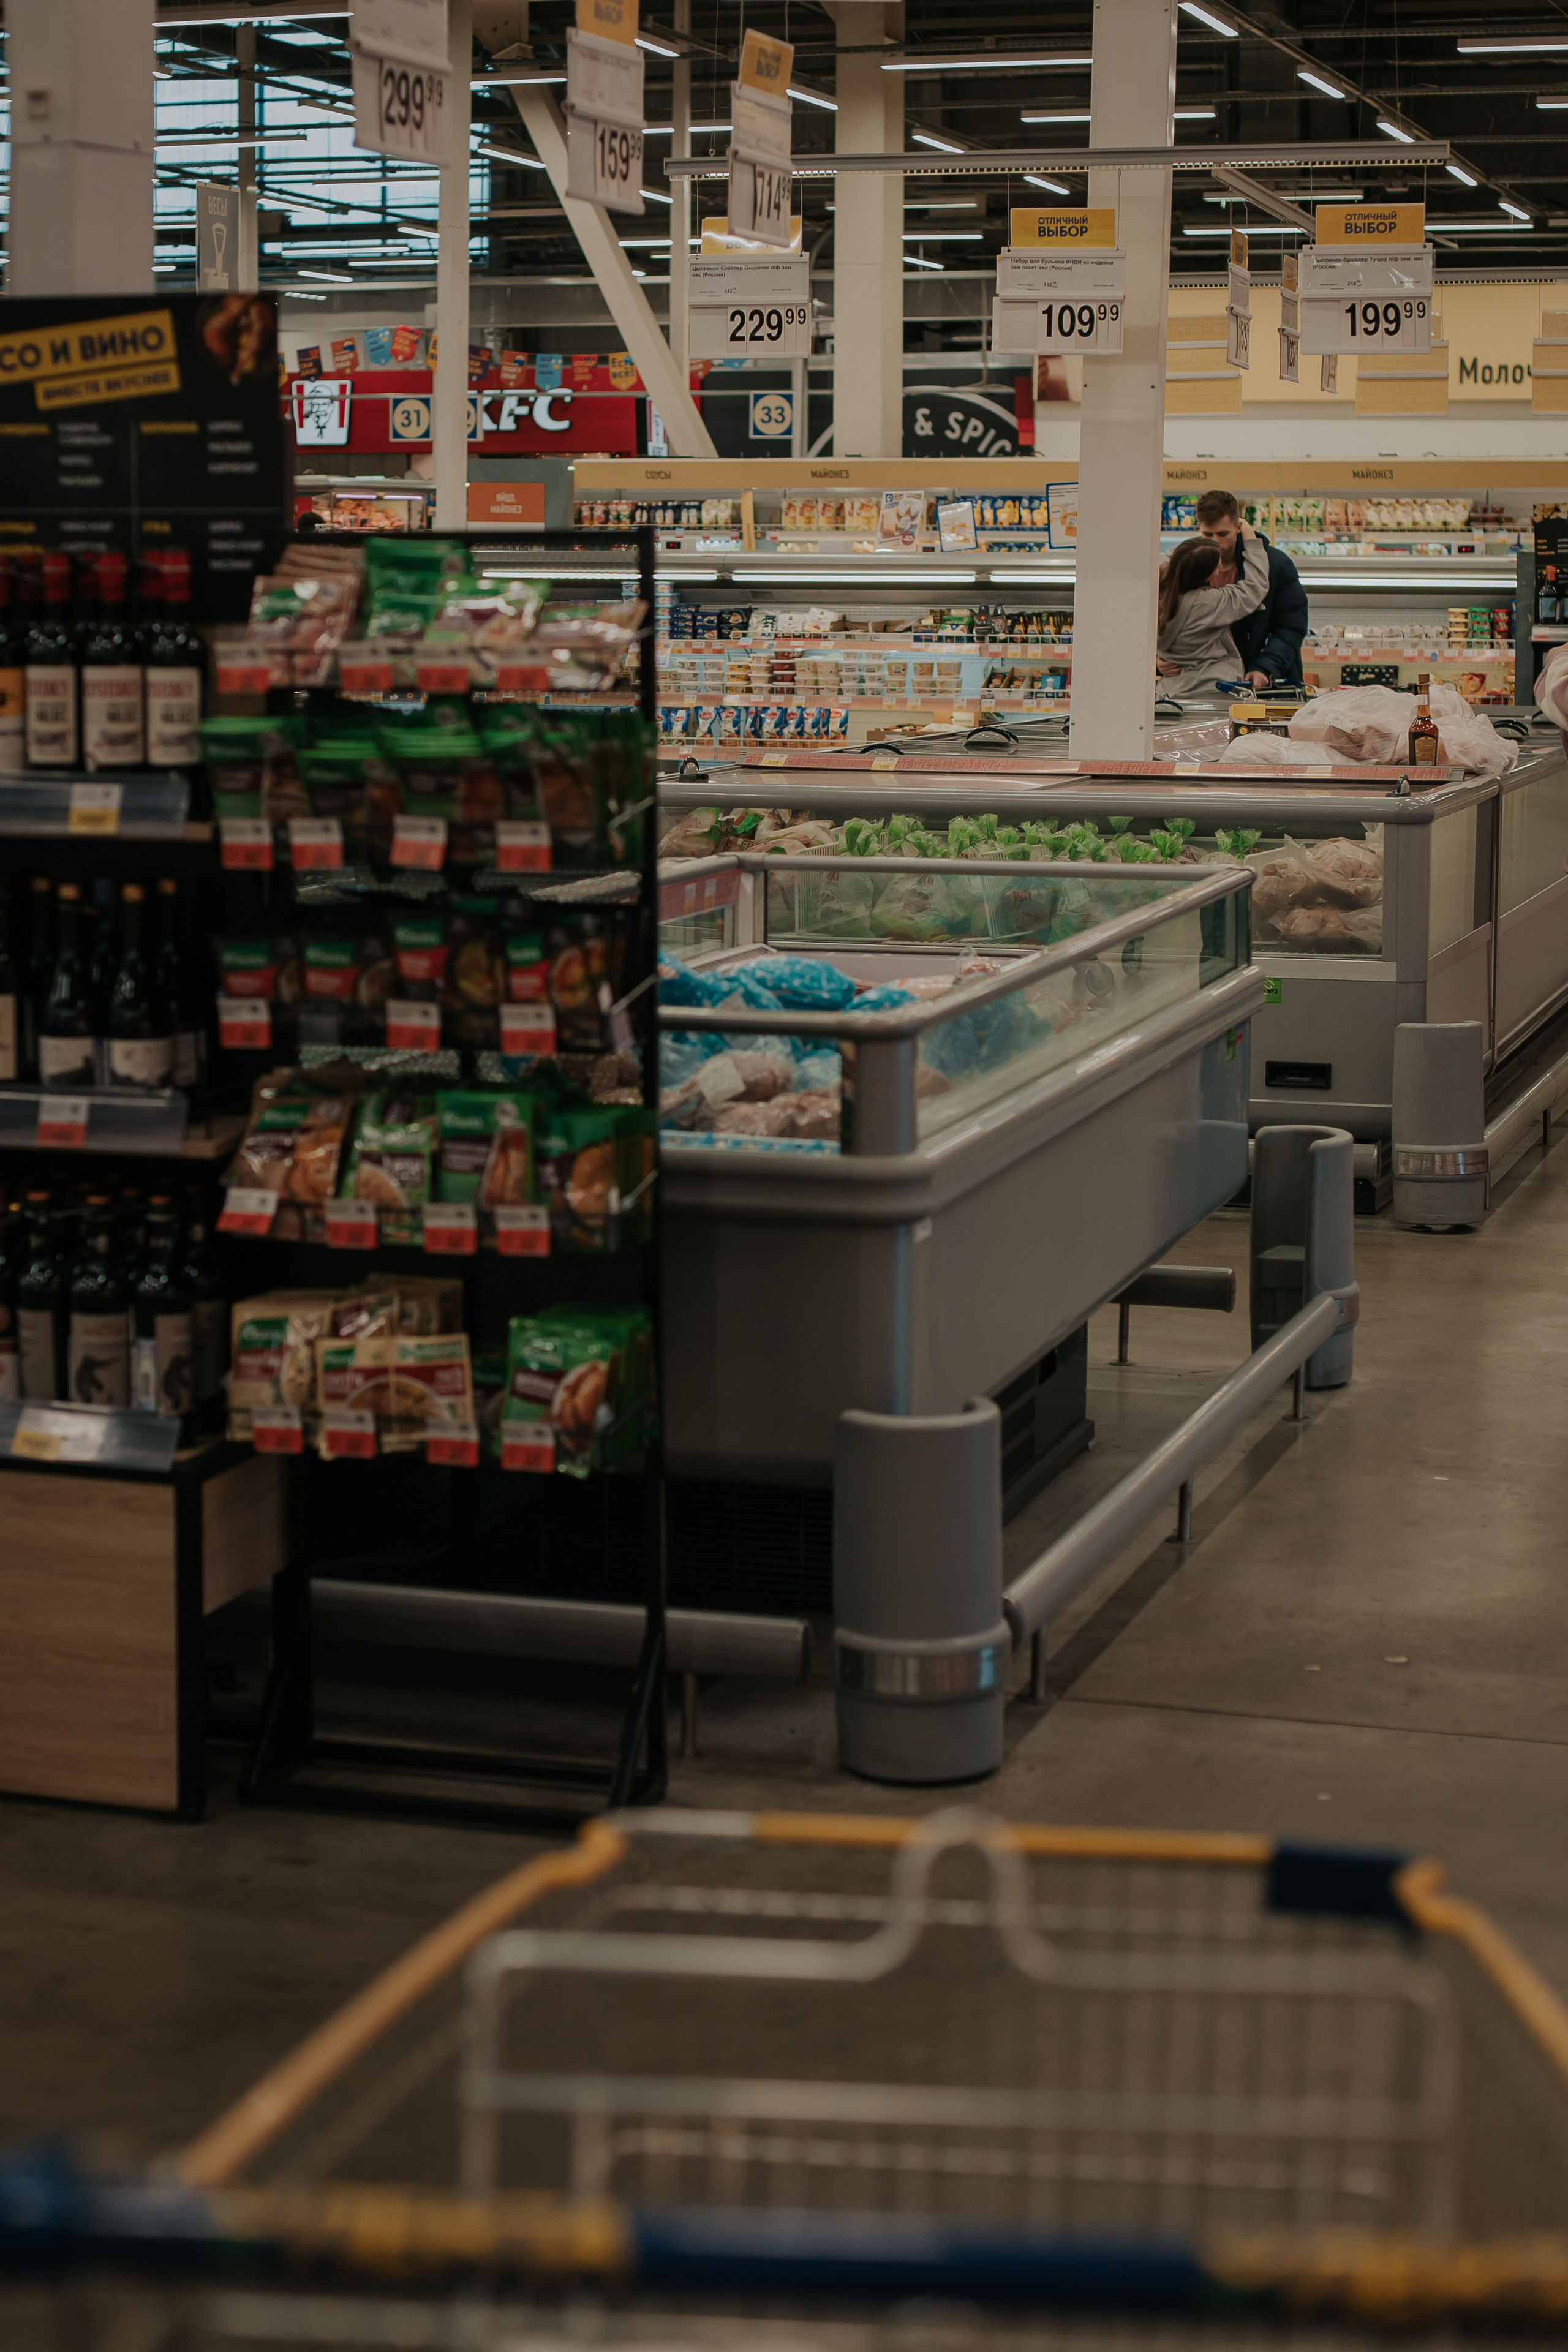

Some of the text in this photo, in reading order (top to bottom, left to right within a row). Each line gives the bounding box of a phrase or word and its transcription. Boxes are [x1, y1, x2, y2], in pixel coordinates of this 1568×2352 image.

[383, 67, 424, 130] 299
[598, 127, 630, 181] 159
[208, 195, 228, 217] ВЕСЫ
[1038, 214, 1088, 225] ОТЛИЧНЫЙ
[1344, 211, 1397, 221] ОТЛИЧНЫЙ
[1038, 225, 1088, 238] ВЫБОР
[1344, 221, 1397, 234] ВЫБОР
[729, 307, 807, 342] 229 99
[1042, 304, 1120, 338] 109 99
[1344, 301, 1427, 337] 199 99
[48, 339, 71, 365] И
[78, 325, 165, 362] ВИНО
[401, 409, 421, 427] 31
[467, 388, 574, 431] KFC
[760, 405, 786, 424] 33
[914, 407, 934, 437] &
[645, 470, 672, 480] СОУСЫ
[810, 467, 850, 479] МАЙОНЕЗ
[1166, 468, 1208, 481] МАЙОНЕЗ
[1352, 467, 1394, 480] МАЙОНЕЗ
[1104, 766, 1156, 775] СВЕЖЕЕ
